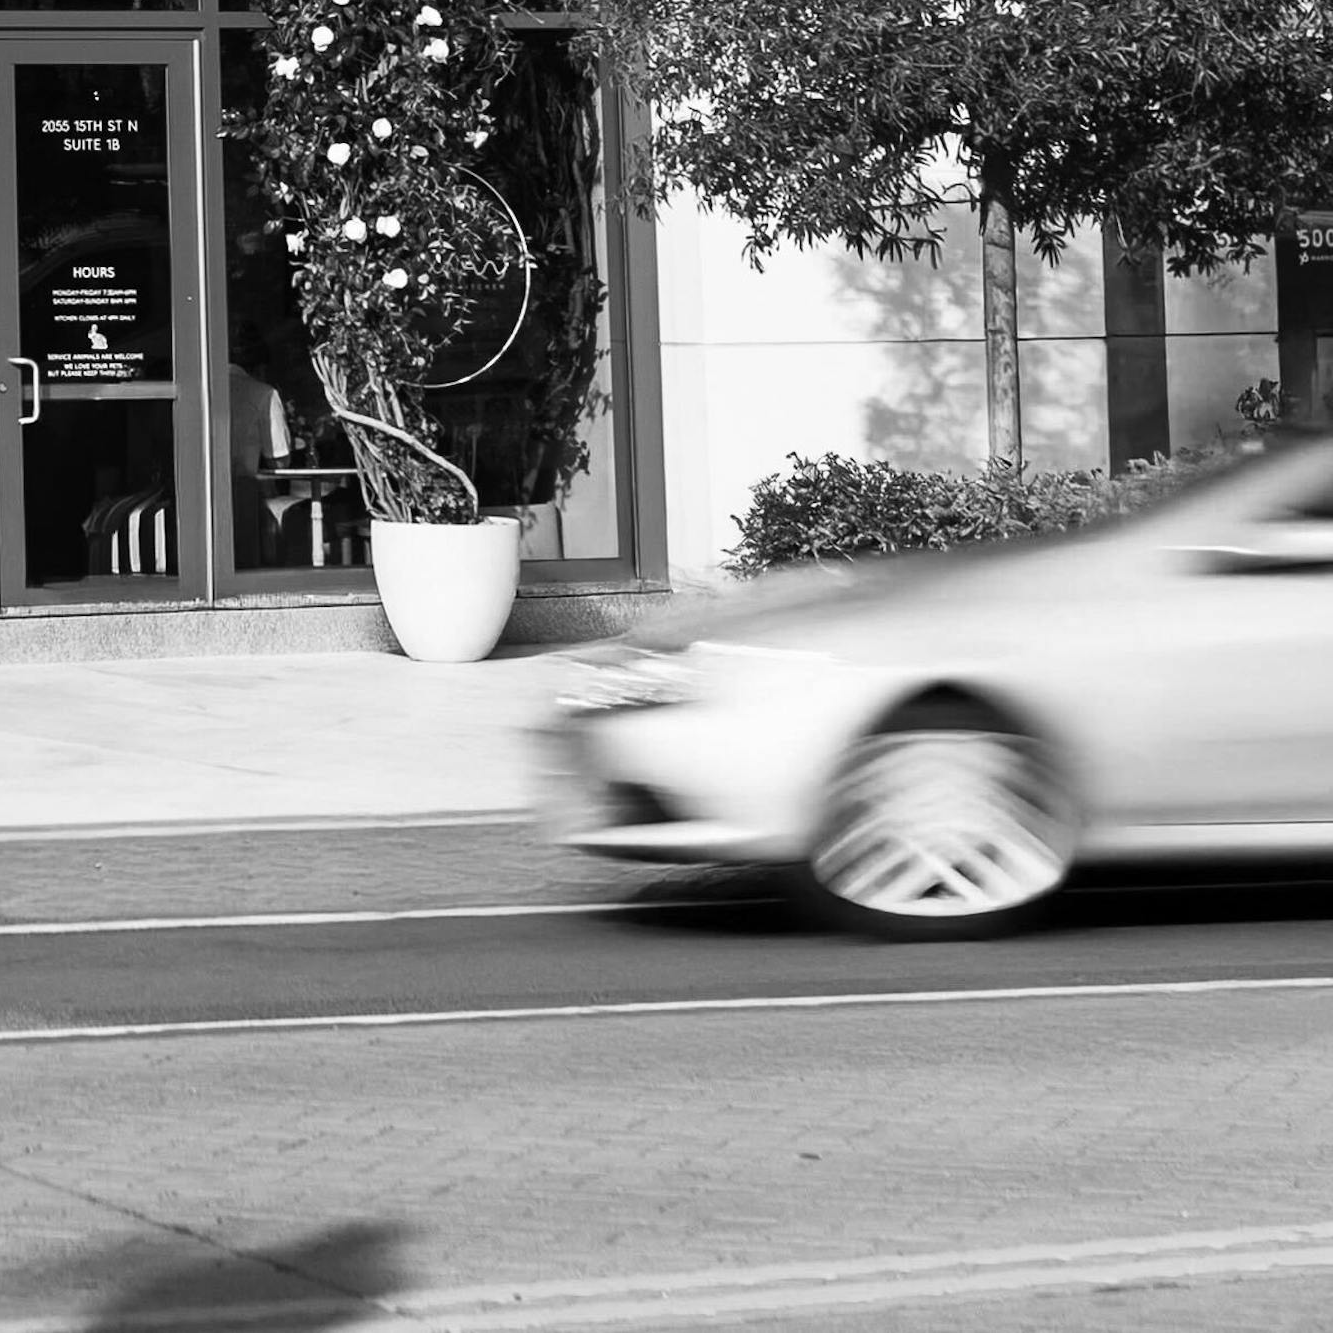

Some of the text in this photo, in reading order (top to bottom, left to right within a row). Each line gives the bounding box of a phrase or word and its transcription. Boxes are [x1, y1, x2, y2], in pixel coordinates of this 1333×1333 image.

[41, 119, 138, 133] 2055 15TH ST N
[63, 137, 121, 151] SUITE 1B
[72, 266, 116, 279] HOURS
[101, 353, 113, 361] ARE
[113, 353, 144, 361] WELCOME
[63, 362, 73, 370] WE
[74, 362, 90, 370] LOVE
[91, 362, 108, 370] YOUR
[47, 369, 59, 378] BUT
[60, 369, 82, 378] PLEASE
[83, 369, 98, 378] KEEP
